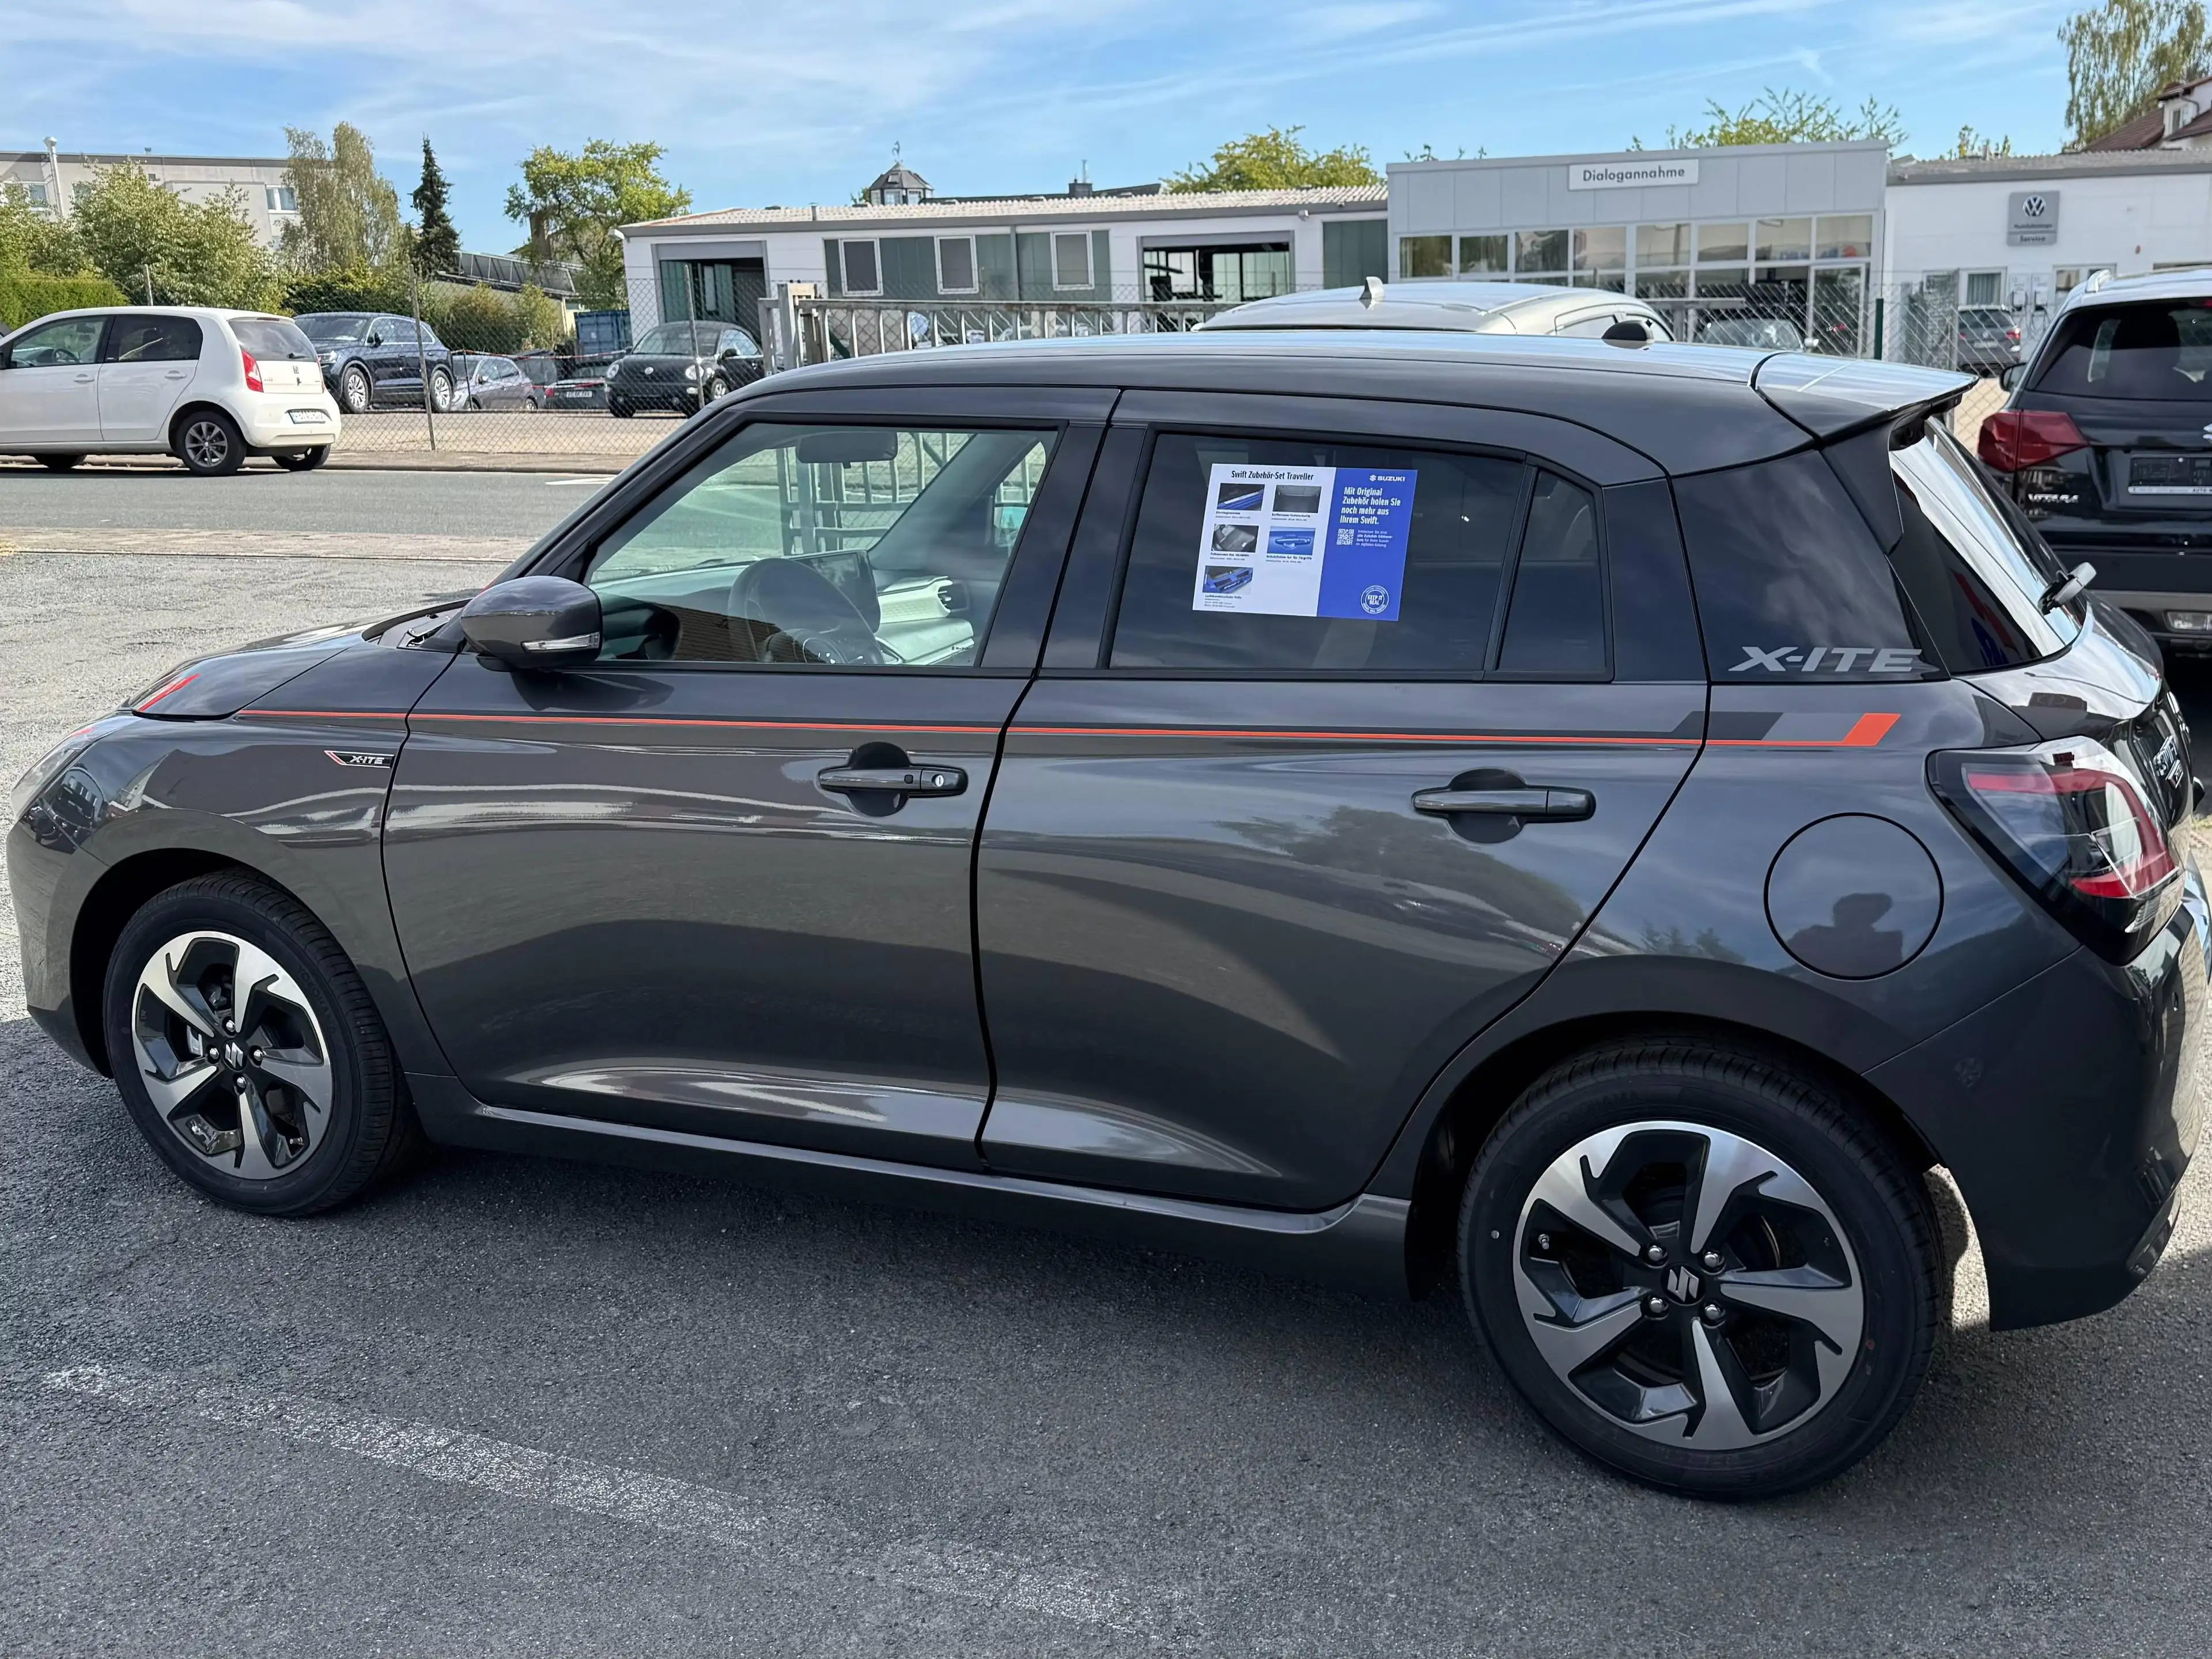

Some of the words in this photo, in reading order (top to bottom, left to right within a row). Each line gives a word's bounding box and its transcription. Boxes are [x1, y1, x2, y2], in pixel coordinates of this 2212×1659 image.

[1582, 165, 1685, 183] Dialogannahme
[1231, 470, 1247, 478] Swift
[1248, 471, 1285, 479] Zubehör-Set
[1287, 472, 1314, 480] Traveller
[1344, 486, 1356, 495] Mit
[1357, 487, 1383, 498] Original
[1342, 496, 1370, 505] Zubehör
[1370, 497, 1389, 506] holen
[1390, 497, 1401, 506] Sie
[1341, 505, 1357, 514] noch
[1359, 506, 1376, 515] mehr
[1377, 507, 1389, 516] aus
[1340, 514, 1359, 524] Ihrem
[1360, 516, 1379, 525] Swift.
[1727, 646, 1923, 673] X-ITE
[349, 755, 385, 765] X-ITE
